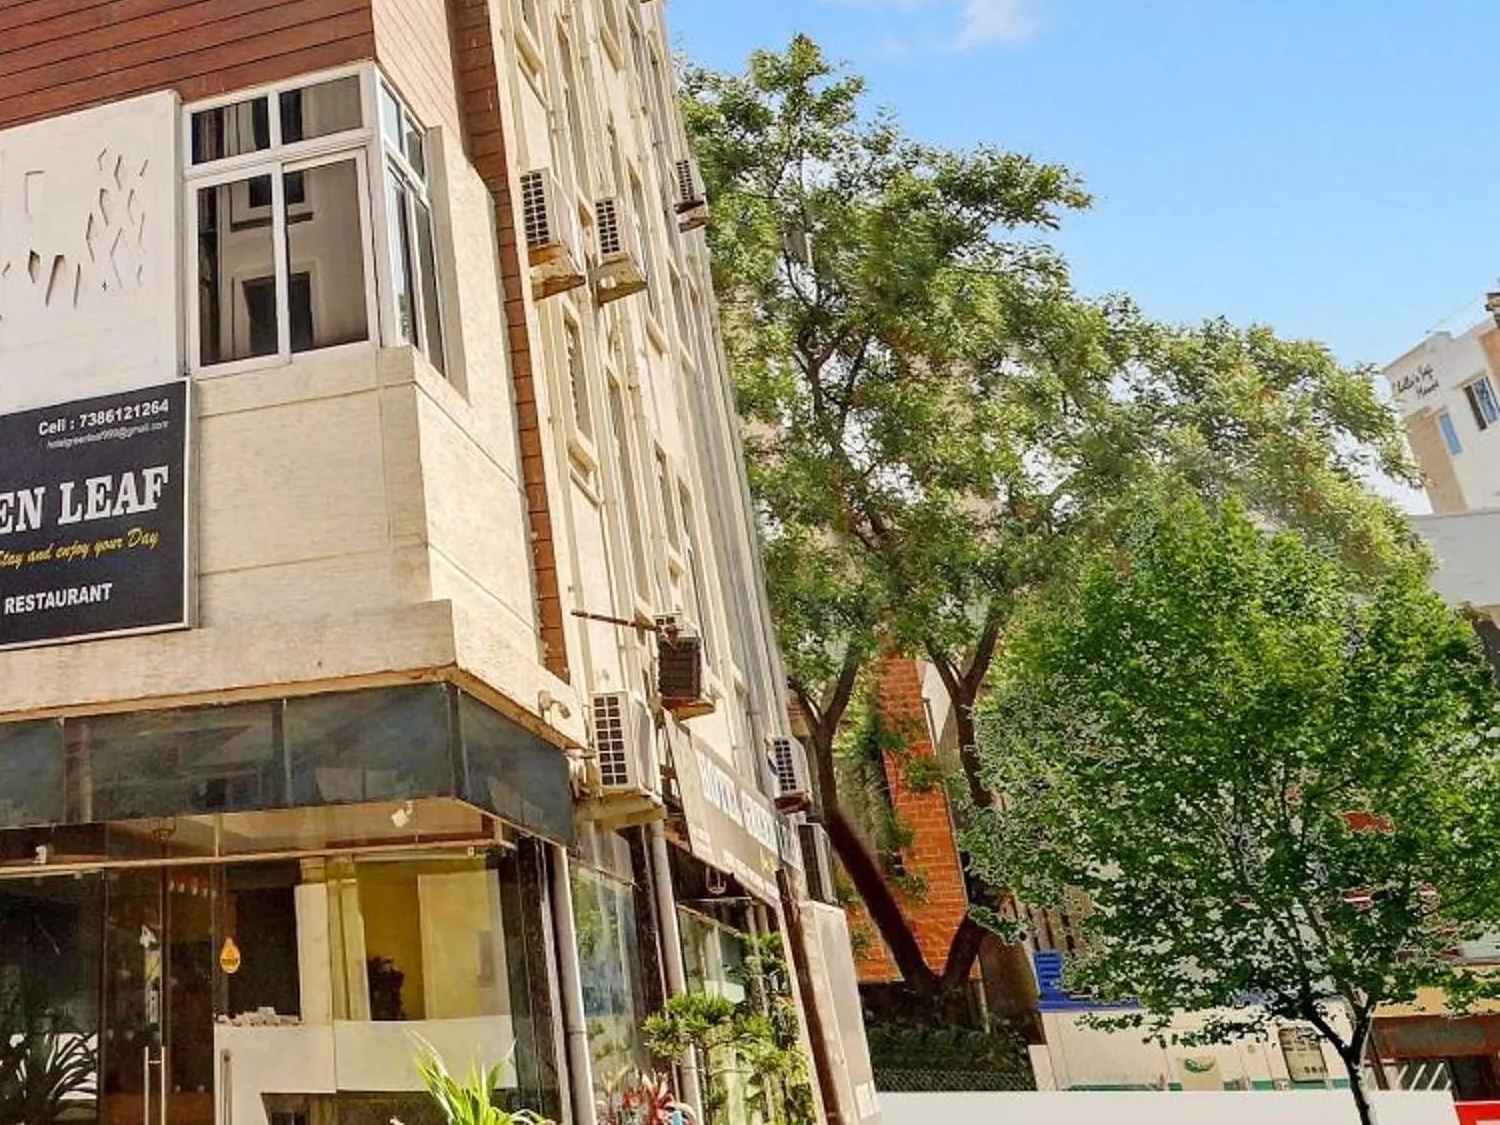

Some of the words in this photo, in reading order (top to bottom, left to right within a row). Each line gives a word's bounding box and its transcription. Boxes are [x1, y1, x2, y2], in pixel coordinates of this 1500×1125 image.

[39, 418, 66, 435] Cell
[79, 398, 169, 428] 7386121264
[57, 465, 169, 526] LEAF
[27, 542, 53, 562] and
[56, 539, 89, 563] enjoy
[93, 538, 122, 559] your
[126, 527, 160, 550] Day
[4, 582, 113, 615] RESTAURANT
